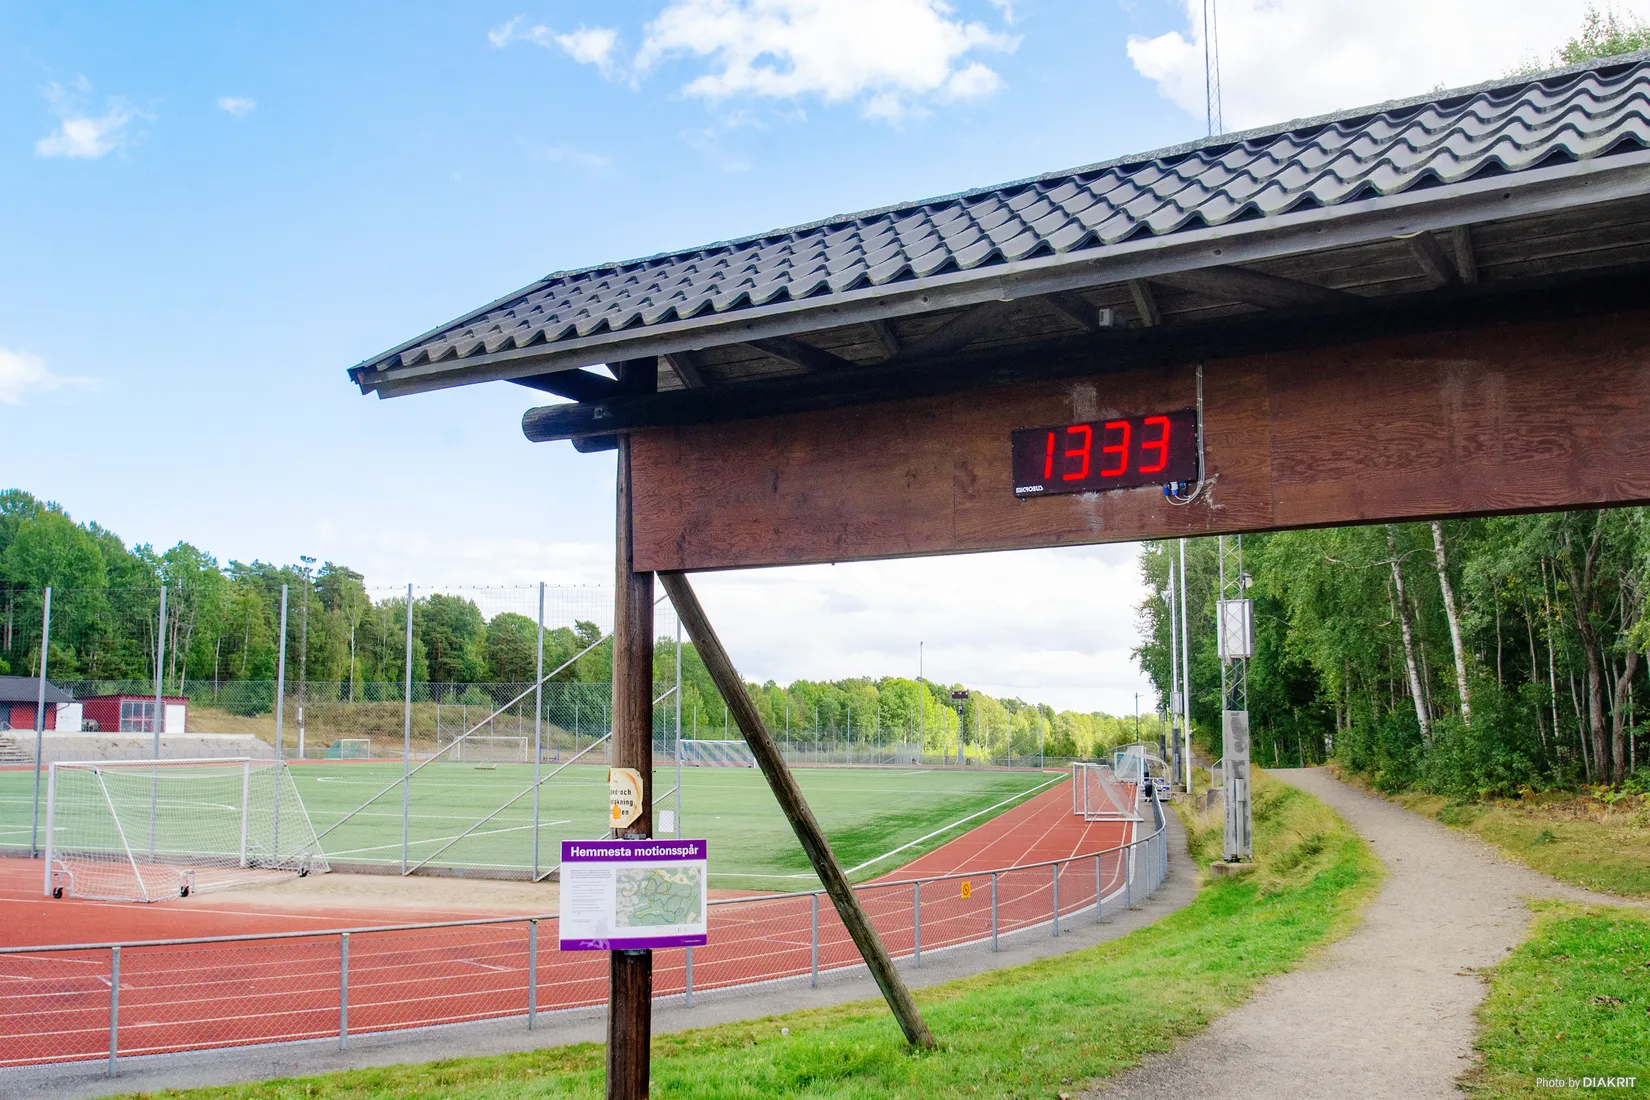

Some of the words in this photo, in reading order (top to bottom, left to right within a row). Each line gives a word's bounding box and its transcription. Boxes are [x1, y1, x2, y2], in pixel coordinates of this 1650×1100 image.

[1043, 416, 1171, 481] 1333
[570, 846, 632, 857] Hemmesta
[634, 843, 699, 857] motionsspår
